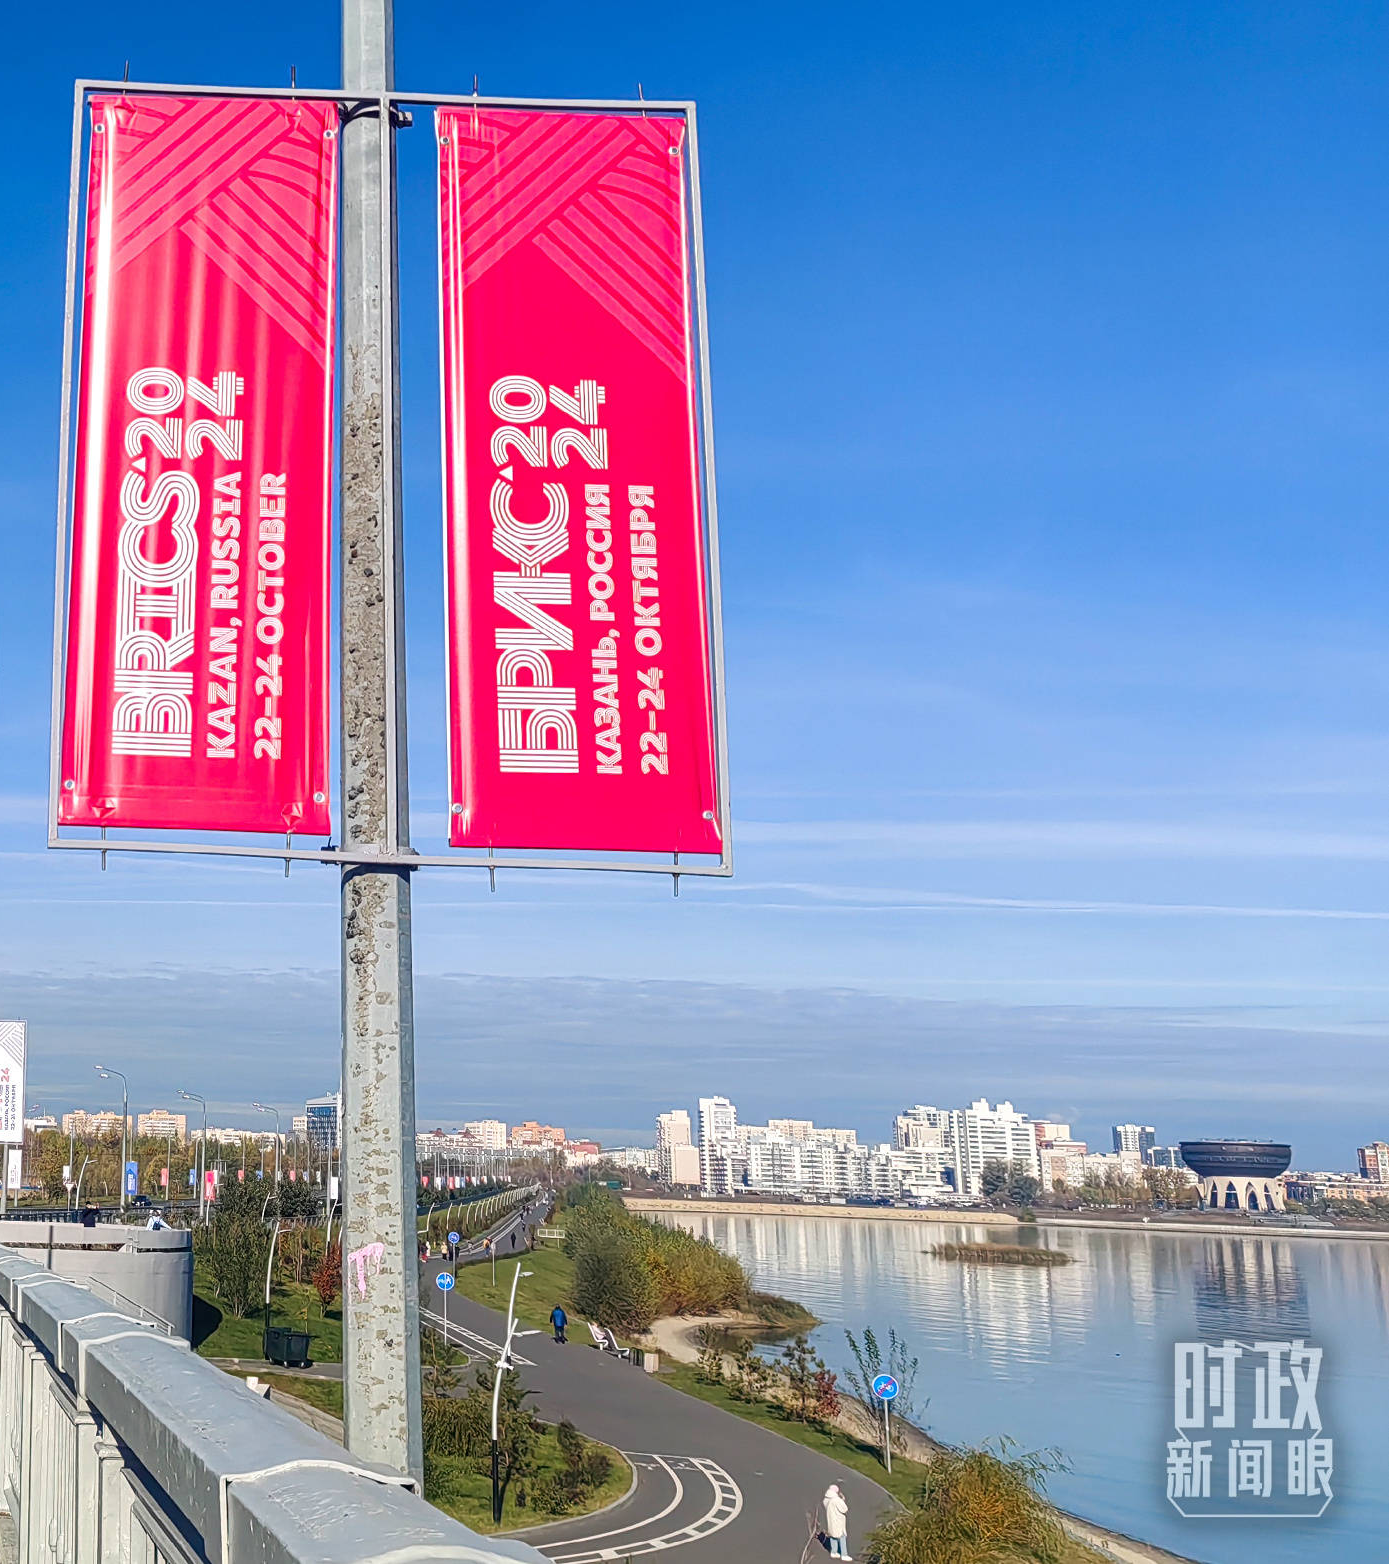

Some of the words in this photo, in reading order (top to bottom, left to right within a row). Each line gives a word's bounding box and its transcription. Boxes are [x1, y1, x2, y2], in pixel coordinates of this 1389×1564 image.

[185, 371, 244, 460] 24
[549, 379, 608, 470] 24
[210, 471, 242, 609] RUSSIA
[256, 473, 286, 645] OCTOBER
[584, 484, 615, 621] РОССИЯ
[628, 485, 663, 656] ОКТЯБРЯ
[206, 617, 243, 758] KAZAN,
[254, 653, 283, 760] 22-24
[591, 629, 623, 774] КАЗАНЬ,
[636, 667, 669, 775] 22-24
